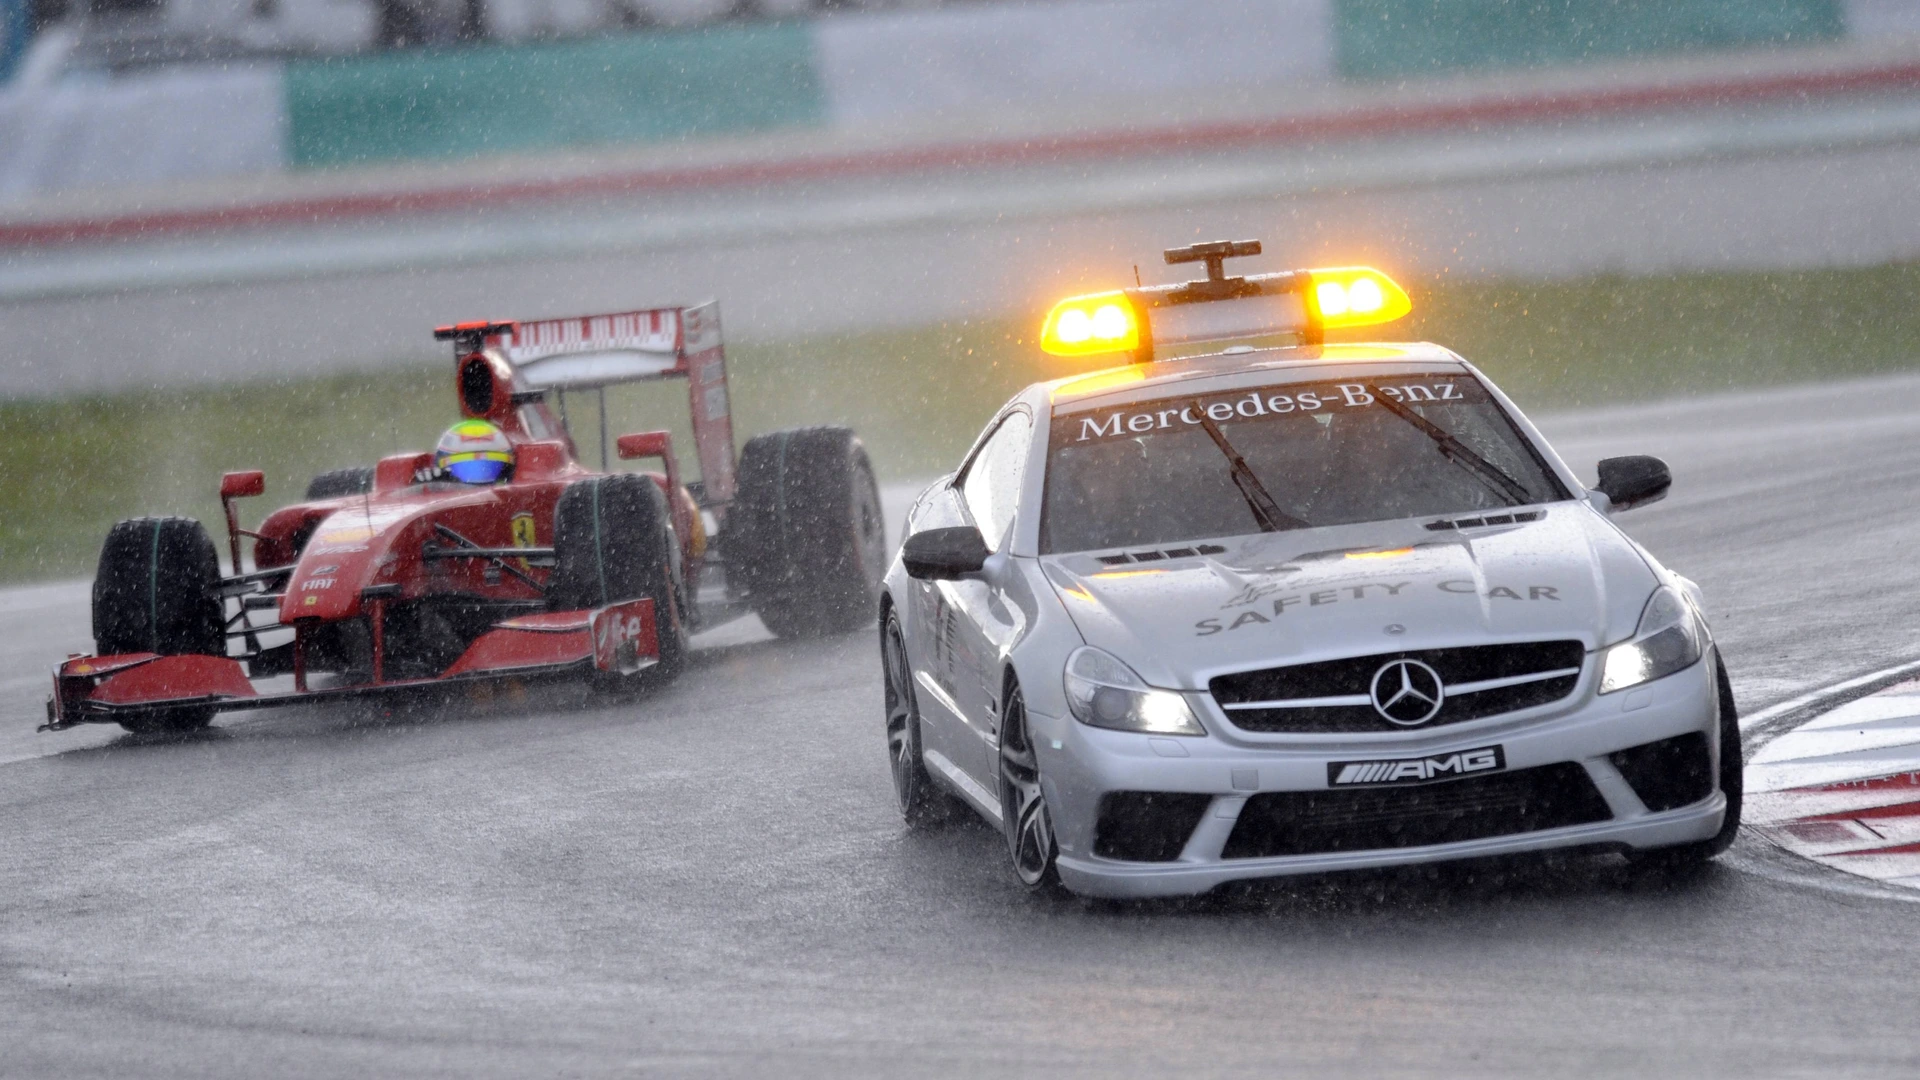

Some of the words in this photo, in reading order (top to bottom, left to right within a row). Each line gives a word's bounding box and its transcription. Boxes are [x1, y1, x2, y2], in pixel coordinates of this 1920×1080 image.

[302, 578, 336, 592] FIAT
[1195, 581, 1412, 636] SAFETY
[1436, 579, 1562, 601] CAR
